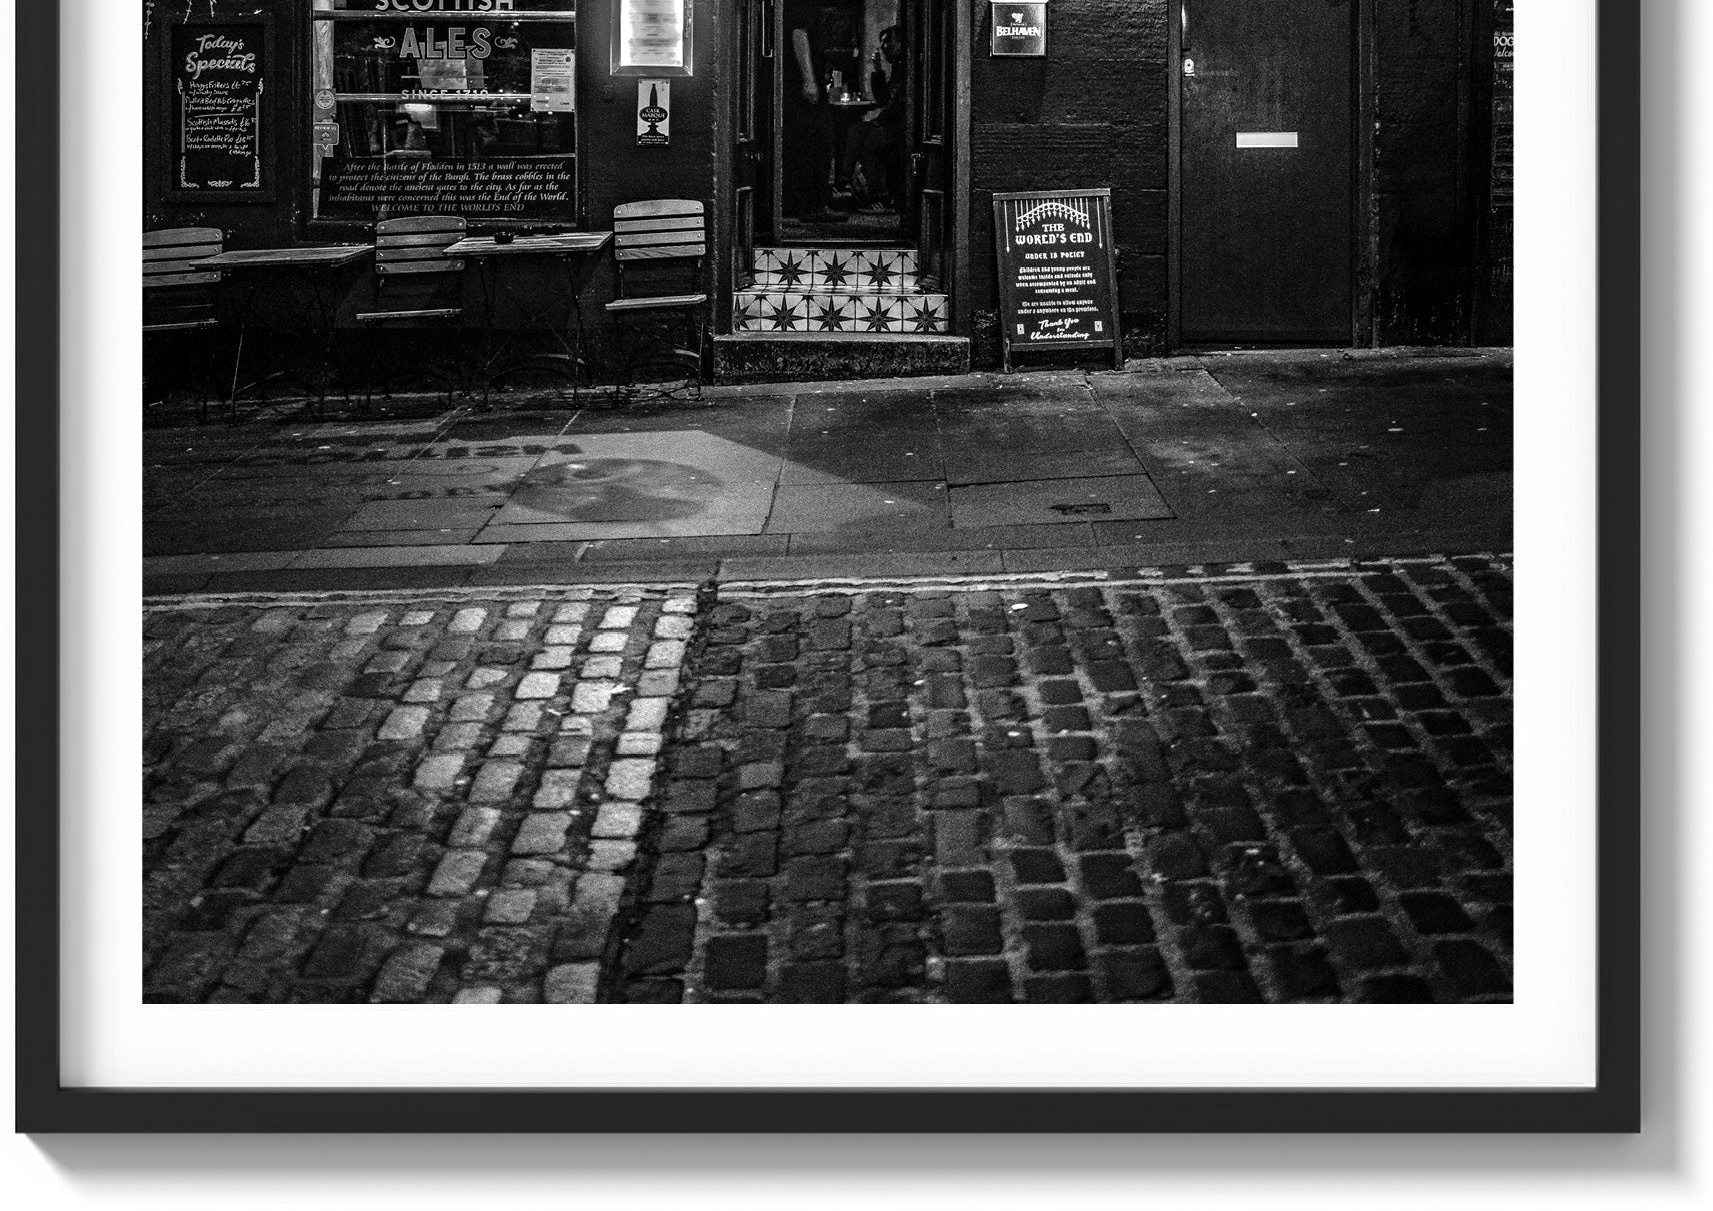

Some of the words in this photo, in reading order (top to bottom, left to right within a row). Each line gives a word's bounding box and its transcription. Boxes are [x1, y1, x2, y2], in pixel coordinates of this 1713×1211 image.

[996, 26, 1042, 37] BELHAVEN
[195, 33, 245, 53] Today's
[399, 27, 492, 59] ALES
[185, 51, 256, 80] Specials
[401, 89, 448, 100] SINCE
[344, 162, 365, 174] After
[410, 162, 420, 174] of
[422, 161, 453, 170] Flodden
[497, 161, 516, 170] wall
[535, 161, 565, 170] erected
[337, 174, 368, 184] protect
[371, 172, 382, 181] the
[418, 172, 429, 183] of
[429, 172, 442, 181] the
[445, 172, 471, 184] Burgh.
[474, 172, 491, 181] The
[492, 172, 513, 181] brass
[515, 172, 543, 181] cobbles
[546, 172, 554, 180] in
[557, 172, 571, 180] the
[340, 183, 360, 191] road
[360, 183, 386, 191] denote
[389, 182, 401, 191] the
[404, 183, 434, 191] ancient
[437, 184, 457, 194] gates
[470, 182, 483, 190] the
[485, 183, 503, 194] city.
[516, 182, 532, 194] far
[546, 181, 559, 190] the
[329, 192, 375, 201] inhabitants
[398, 190, 440, 201] concerned
[442, 192, 457, 201] this
[478, 192, 491, 201] the
[494, 192, 512, 201] End
[513, 192, 524, 204] of
[524, 192, 537, 201] the
[540, 192, 569, 201] World.
[504, 203, 525, 211] END
[1042, 224, 1065, 232] THE
[1015, 233, 1067, 245] WORLD'S
[1069, 232, 1093, 243] END
[1038, 319, 1063, 330] Thank
[1065, 318, 1080, 329] You
[1030, 331, 1090, 340] Understanding
